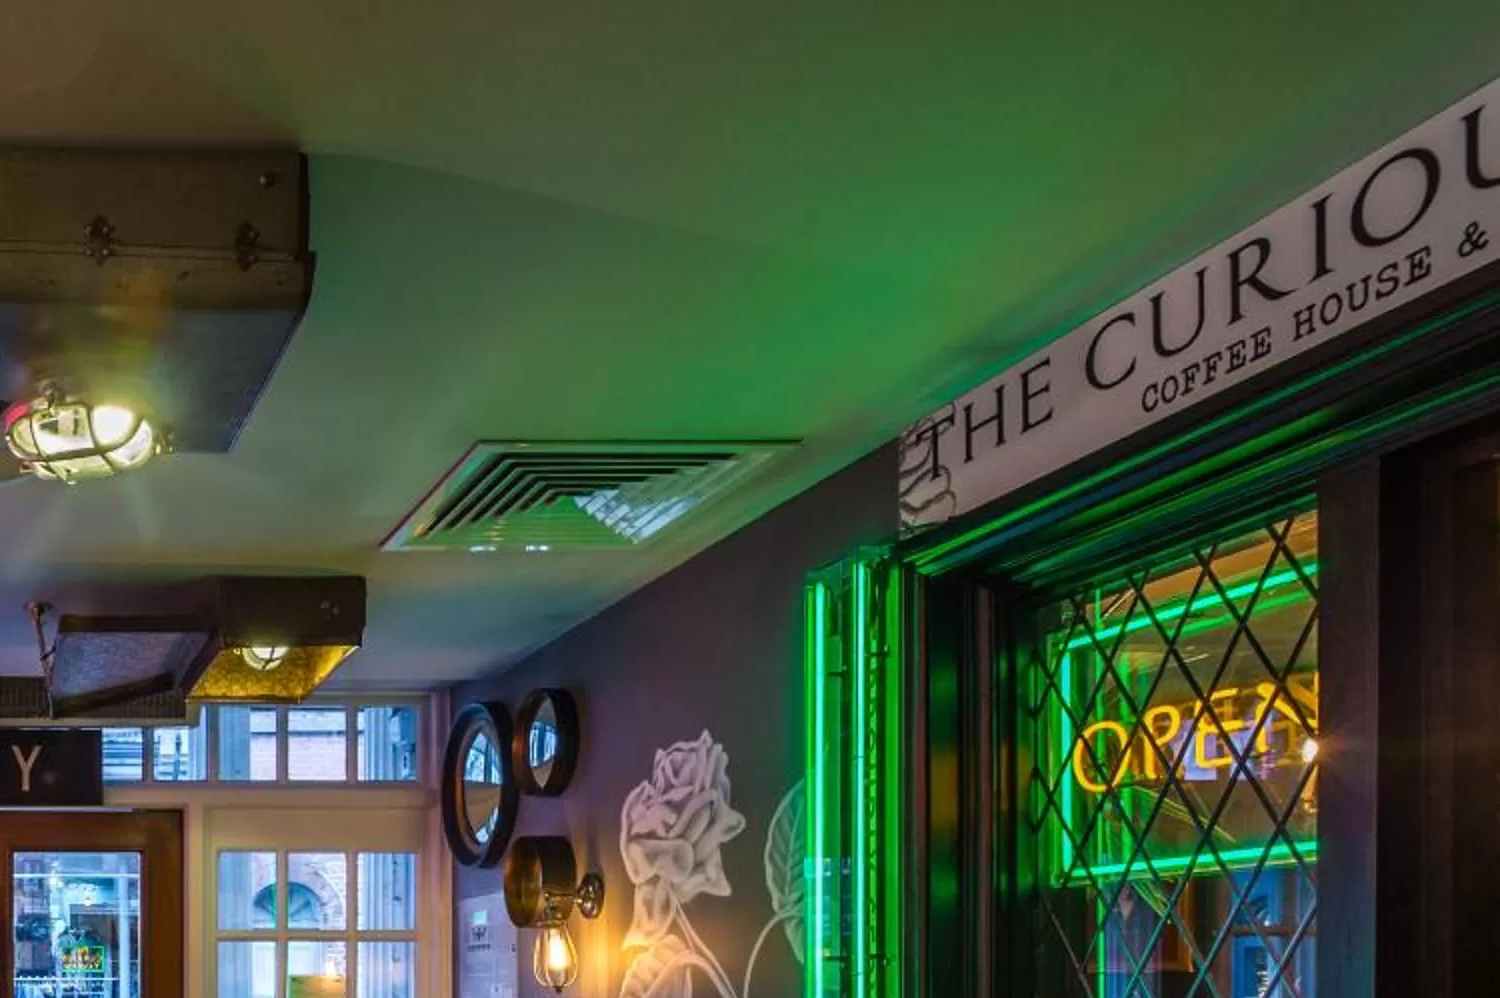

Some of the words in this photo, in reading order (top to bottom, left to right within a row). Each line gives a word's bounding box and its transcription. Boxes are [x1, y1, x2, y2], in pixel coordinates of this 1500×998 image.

[1140, 326, 1273, 414] COFFEE
[1292, 246, 1432, 342] HOUSE
[1457, 221, 1489, 258] &
[915, 358, 1054, 481] THE
